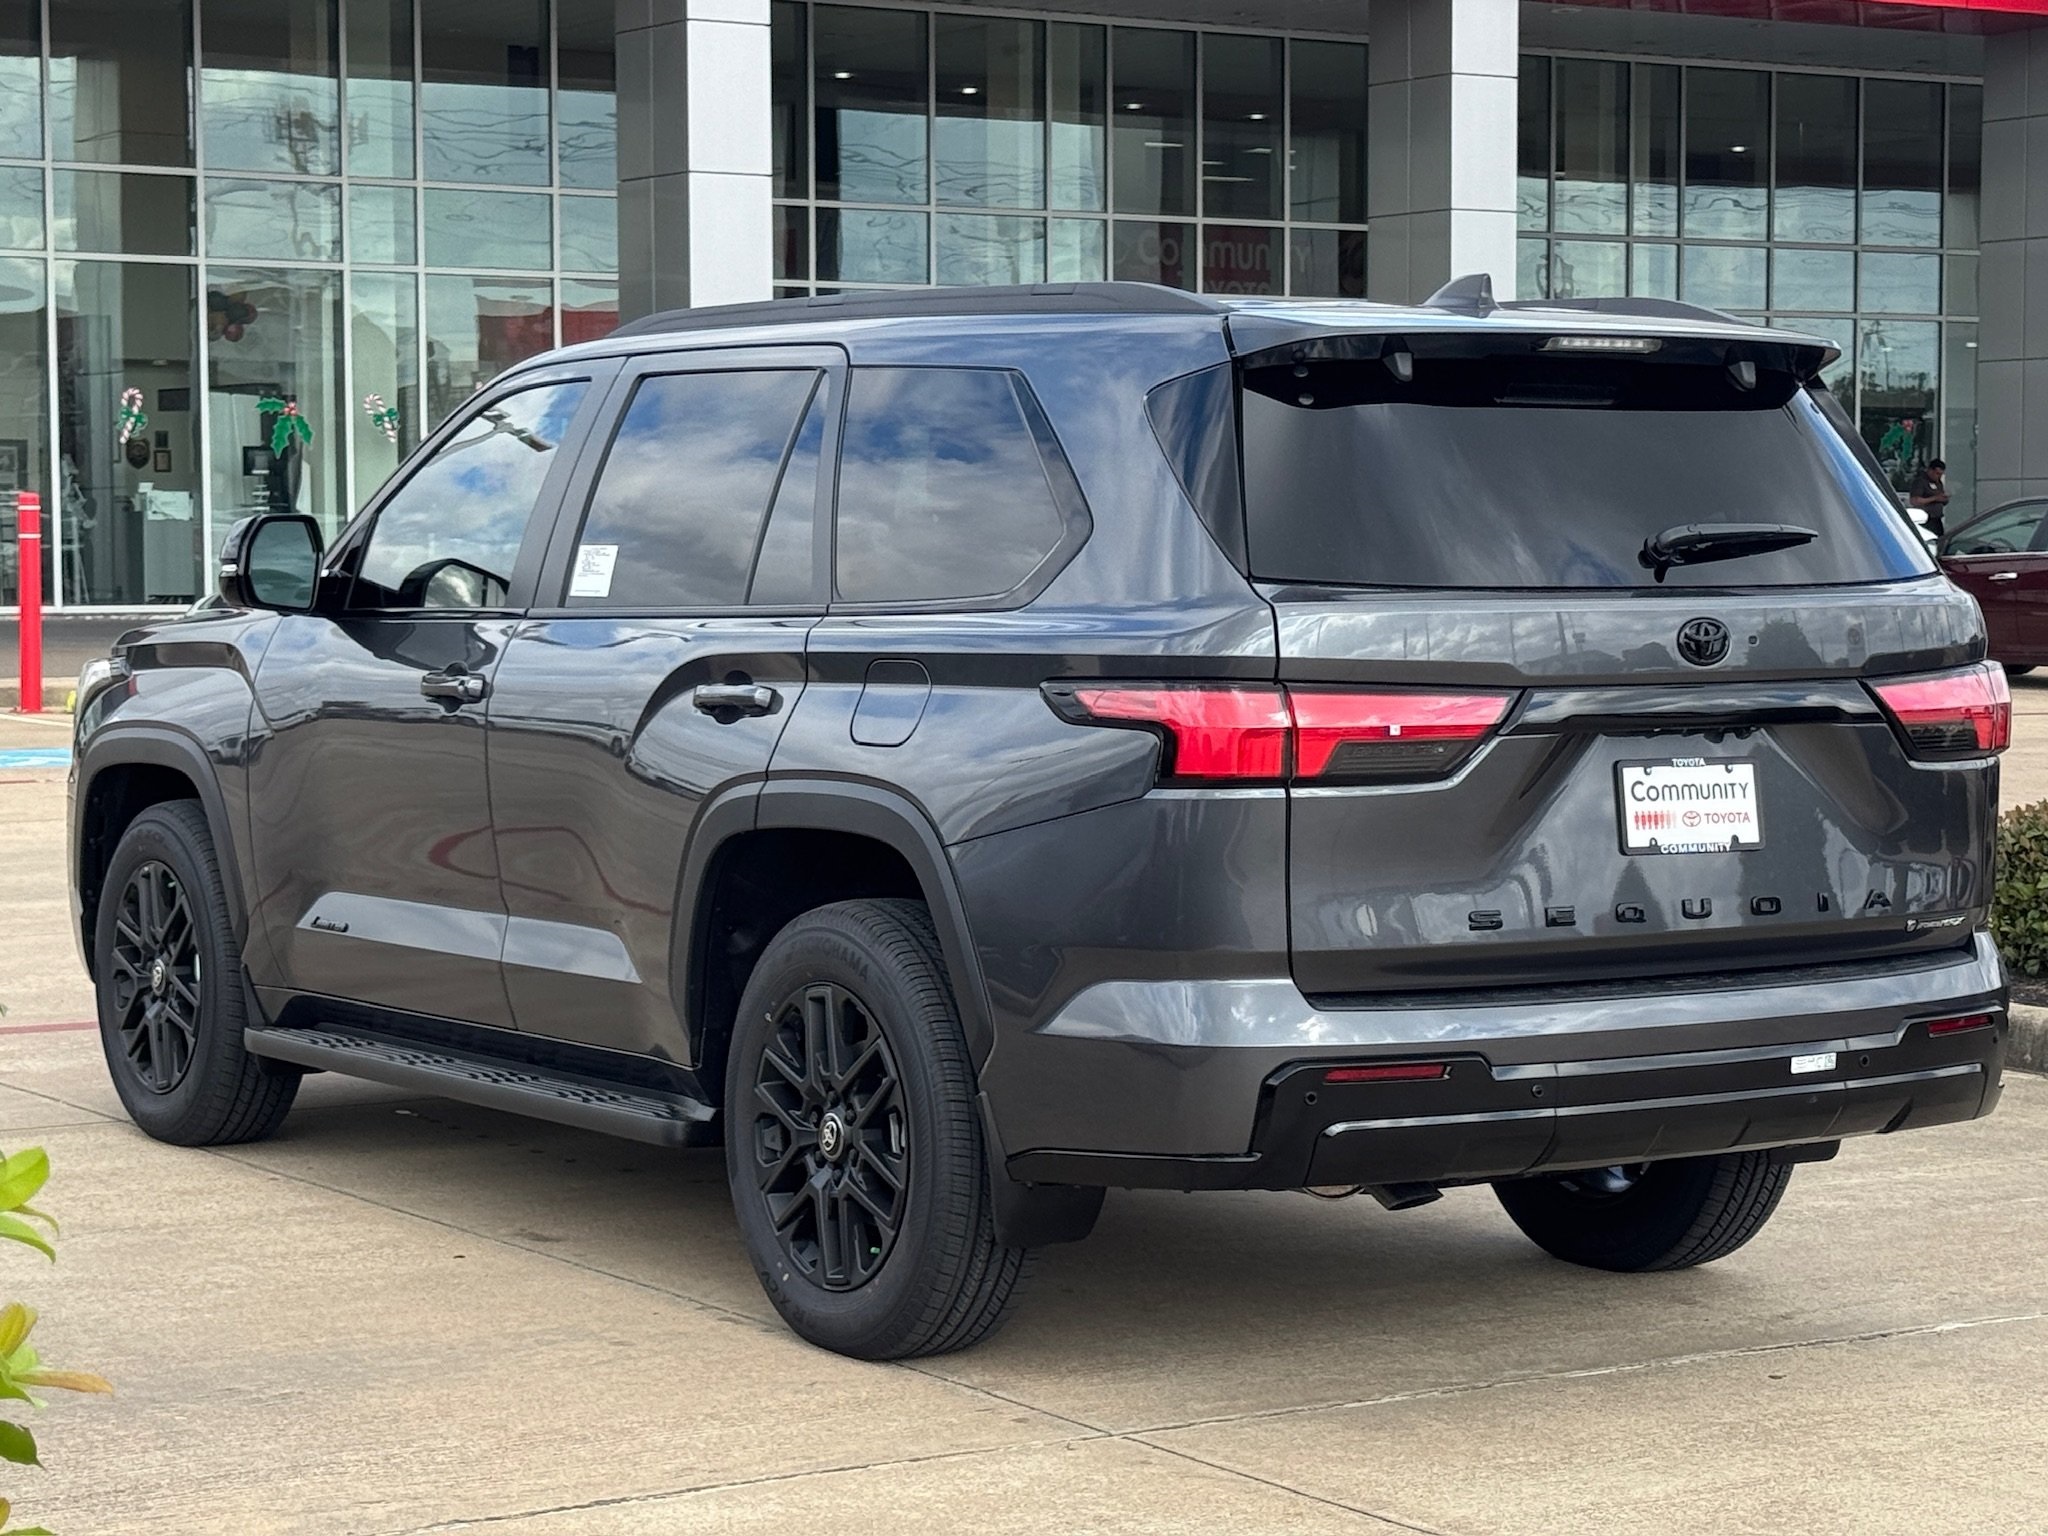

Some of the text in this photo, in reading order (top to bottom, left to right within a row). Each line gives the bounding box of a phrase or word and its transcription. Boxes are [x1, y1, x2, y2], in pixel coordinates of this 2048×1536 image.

[1671, 757, 1706, 767] TOYOTA
[1704, 811, 1751, 825] TOYOTA
[1660, 842, 1731, 854] COMMUNITY
[1468, 888, 1892, 931] SEQUOIA
